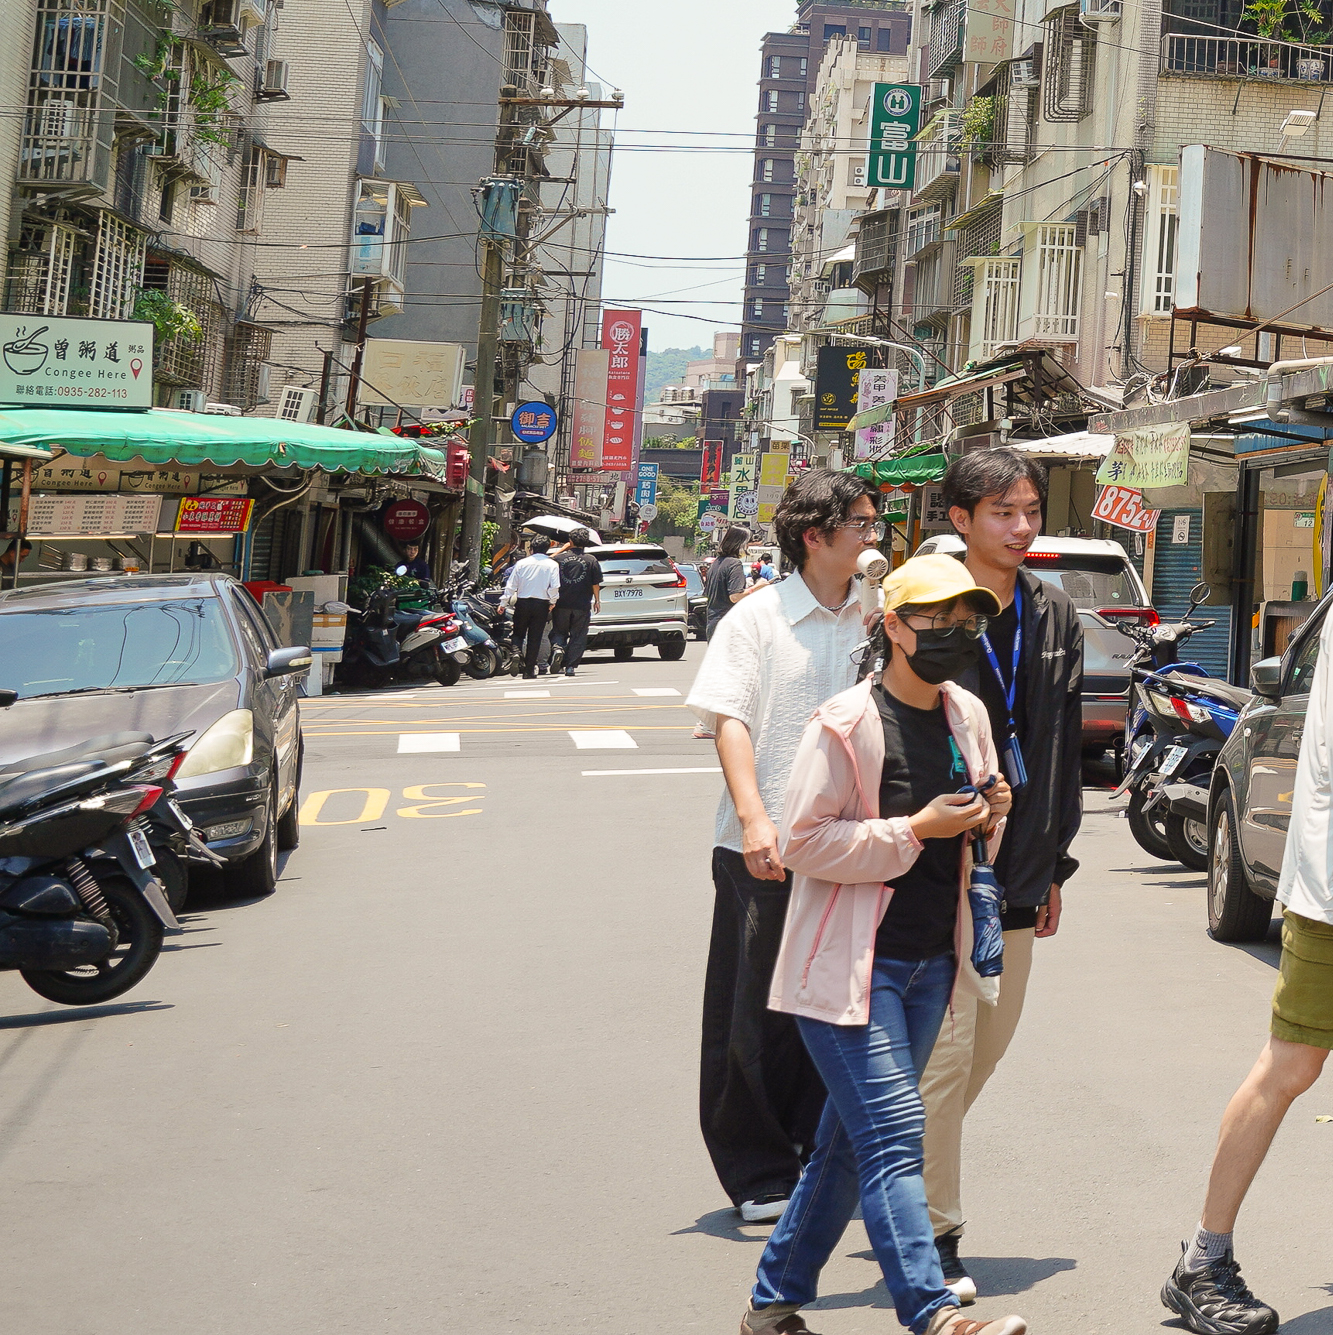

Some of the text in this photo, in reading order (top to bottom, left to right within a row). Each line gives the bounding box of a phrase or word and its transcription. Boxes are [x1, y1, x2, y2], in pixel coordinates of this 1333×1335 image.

[877, 120, 911, 184] 富山
[54, 338, 121, 363] 曾粥道
[610, 327, 631, 369] 勝太郎
[45, 367, 127, 379] Congee Here
[518, 411, 552, 427] 御吉
[41, 479, 71, 487] Congee
